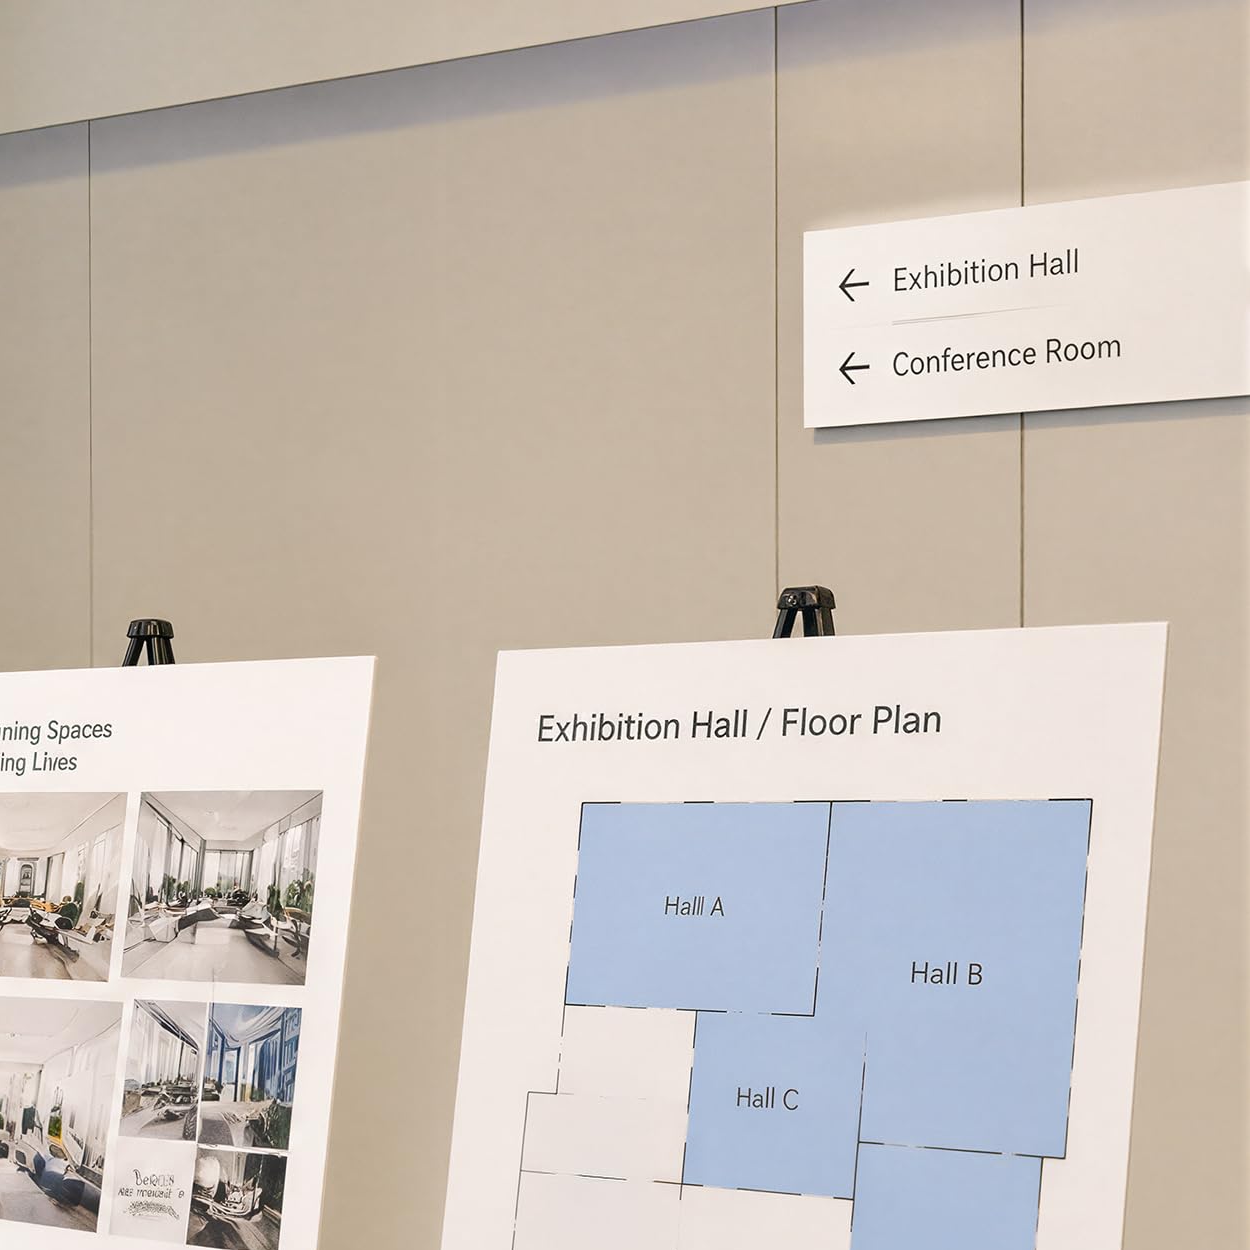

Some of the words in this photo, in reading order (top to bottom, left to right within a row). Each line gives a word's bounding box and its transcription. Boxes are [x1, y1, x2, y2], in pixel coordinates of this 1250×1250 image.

[894, 258, 1019, 292] Exhibition
[1029, 247, 1079, 279] Hall
[892, 346, 1037, 377] Conference
[1046, 337, 1121, 364] Room
[46, 719, 113, 745] Spaces
[537, 712, 680, 743] Exhibition
[691, 708, 749, 739] Hall
[755, 707, 773, 741] /
[781, 706, 863, 737] Floor
[872, 703, 942, 735] Plan
[709, 896, 725, 917] A
[911, 960, 958, 985] Hall
[967, 962, 983, 986] B
[736, 1086, 775, 1109] Hall
[782, 1088, 799, 1111] C
